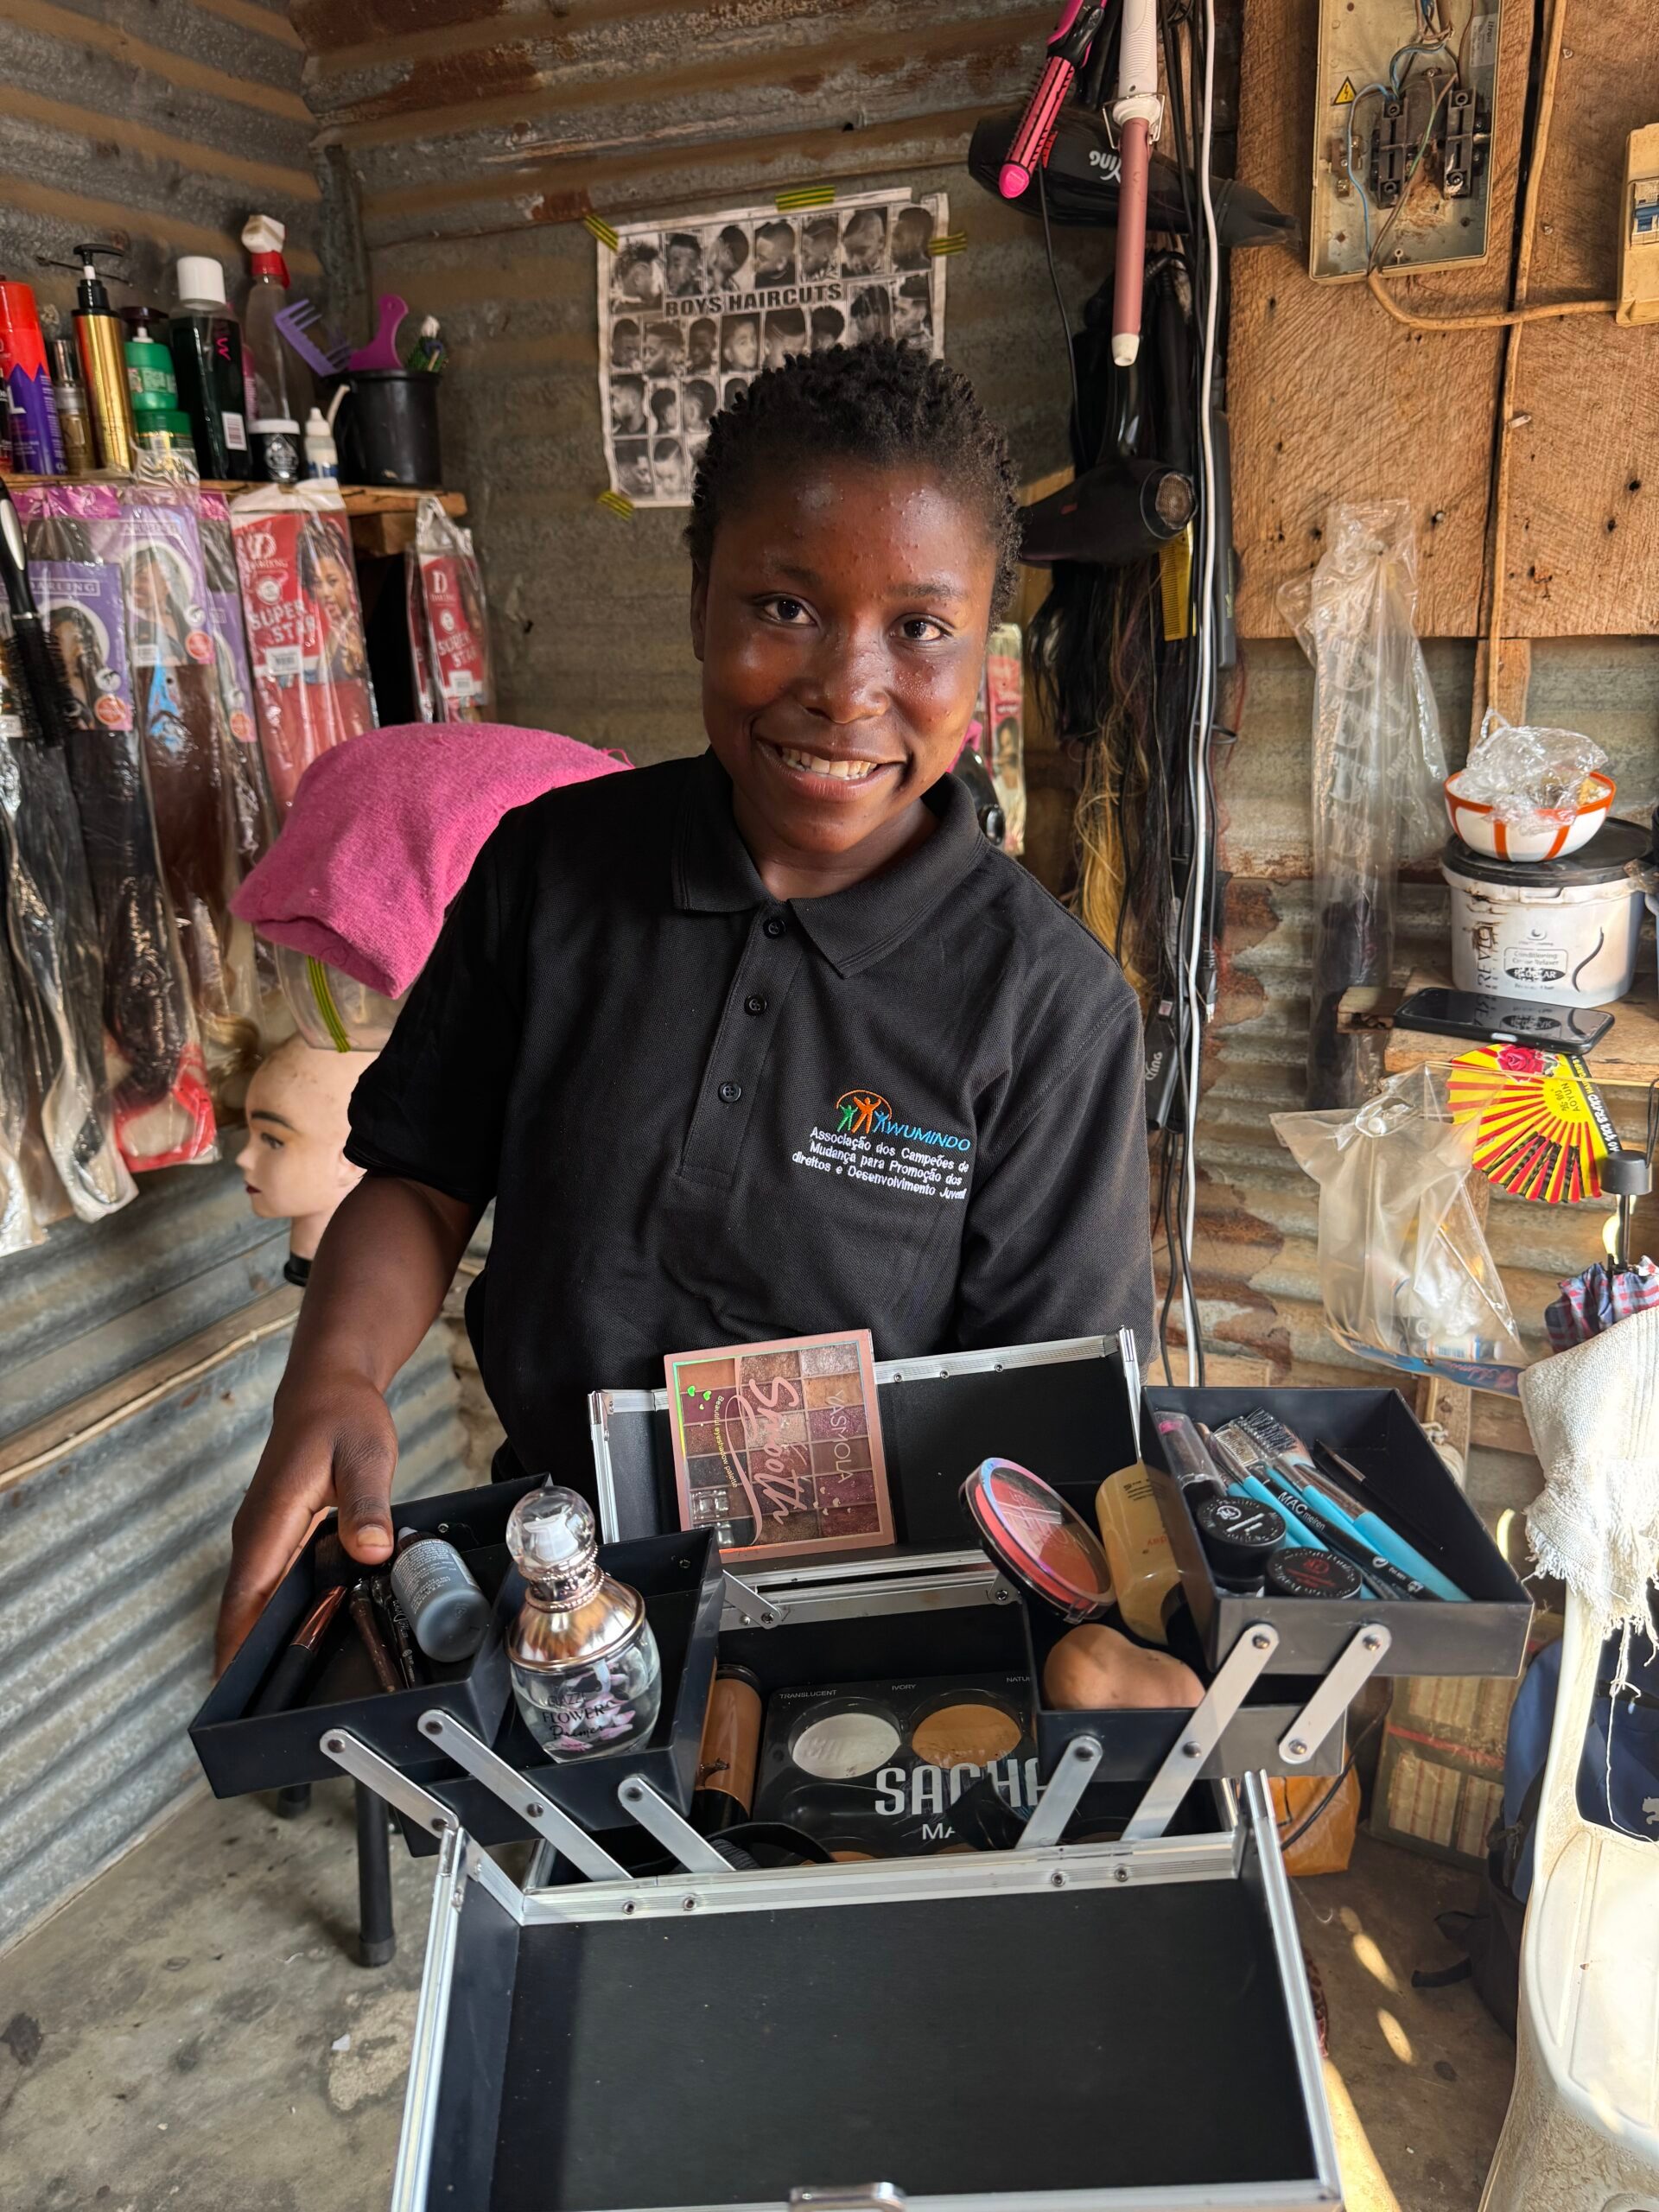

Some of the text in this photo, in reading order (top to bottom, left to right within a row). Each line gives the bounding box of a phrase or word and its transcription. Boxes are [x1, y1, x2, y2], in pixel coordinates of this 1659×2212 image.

[665, 283, 842, 317] BOYS HAIRCUTS
[250, 600, 307, 631] SUPER
[272, 617, 317, 643] STAR
[1560, 1082, 1580, 1112] AOYUN
[810, 1127, 969, 1173] Associação dos Campeões de
[810, 1141, 962, 1185] Mudança para Promoção dos
[792, 1151, 831, 1173] direitos
[836, 1166, 842, 1174] e
[848, 1166, 936, 1196] Desenvolvimento
[713, 1395, 738, 1489] Beautiful eyeshadow palette
[1278, 1491, 1308, 1516] MAC
[779, 1689, 837, 1700] TRANSLUCENT
[542, 1703, 606, 1725] FLOWER
